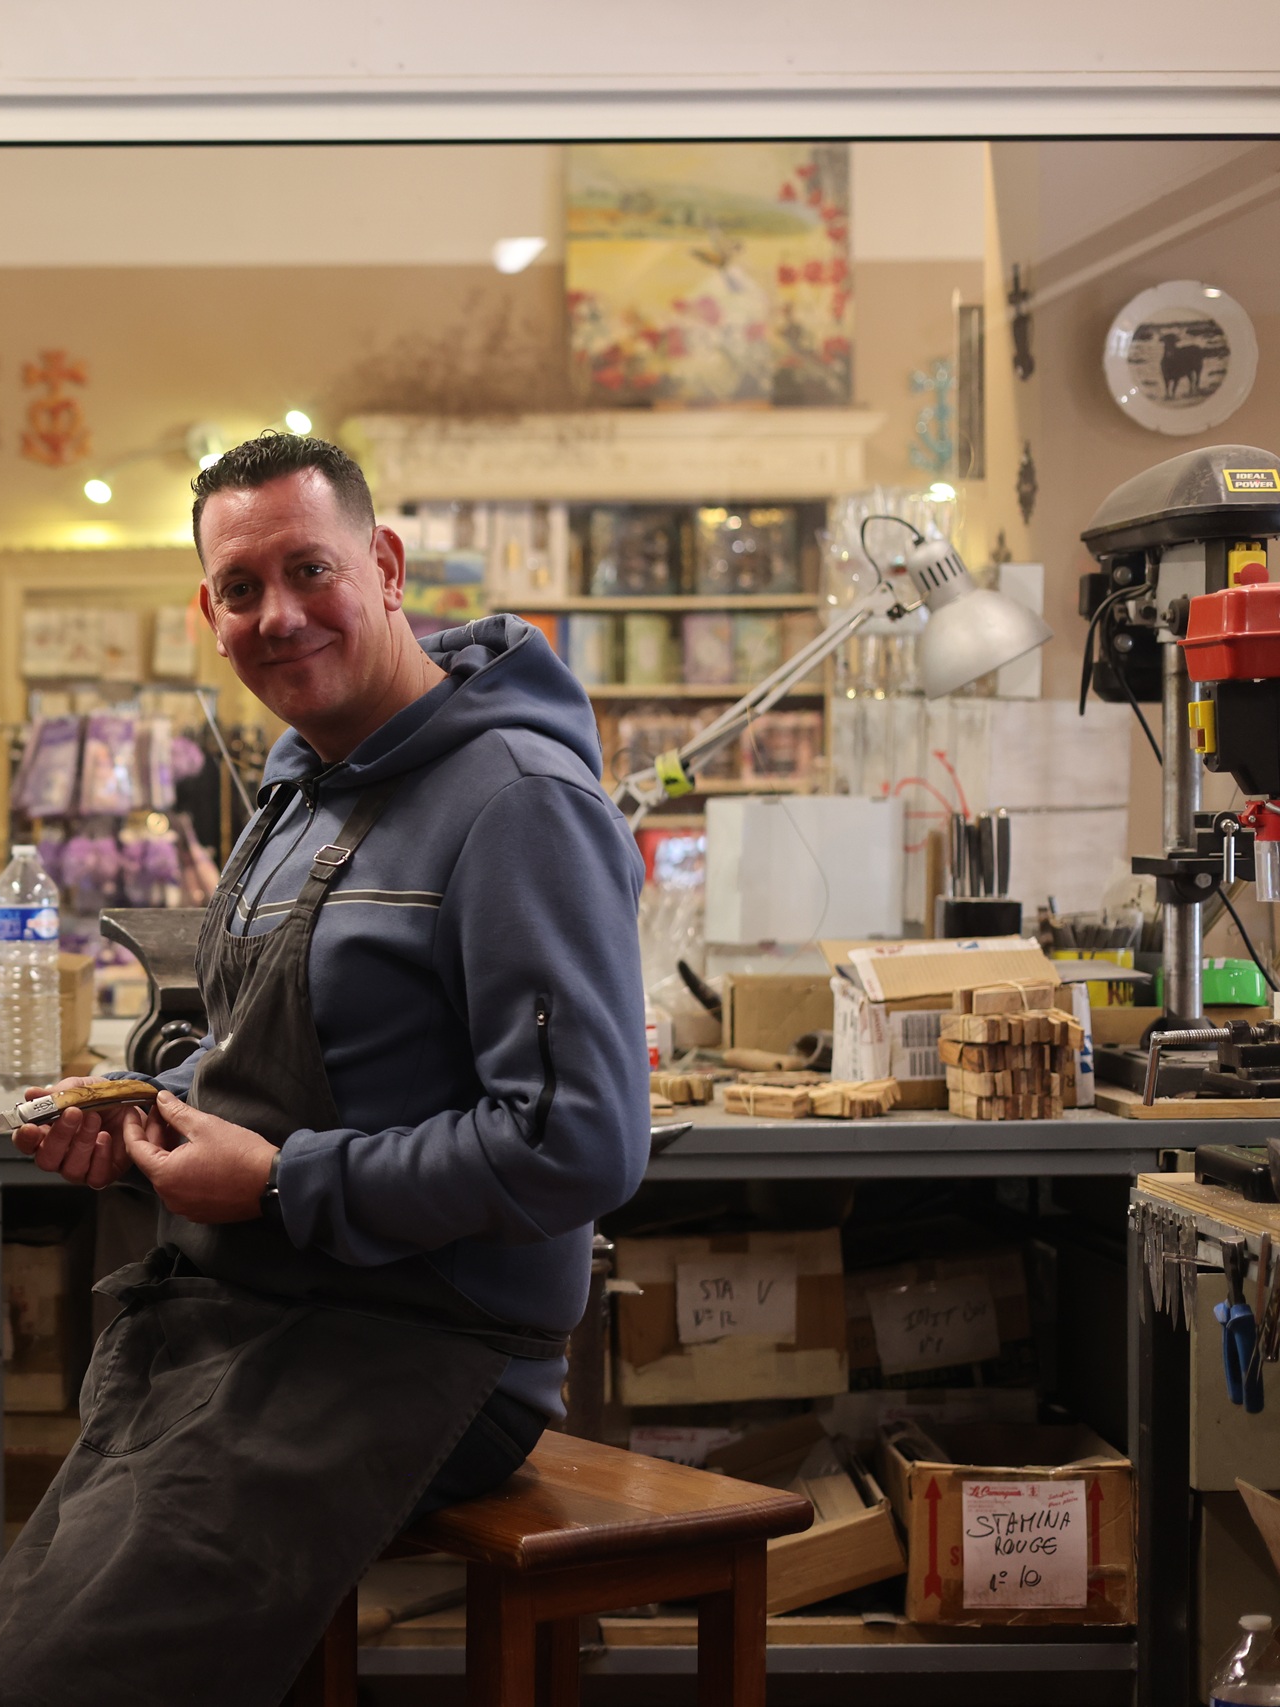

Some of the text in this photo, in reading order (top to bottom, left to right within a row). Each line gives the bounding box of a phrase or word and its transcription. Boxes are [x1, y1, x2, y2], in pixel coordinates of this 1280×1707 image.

[699, 1277, 775, 1305] STA V
[966, 1509, 1071, 1538] STAMINA
[995, 1536, 1058, 1556] ROUGE
[1019, 1564, 1042, 1589] 10
